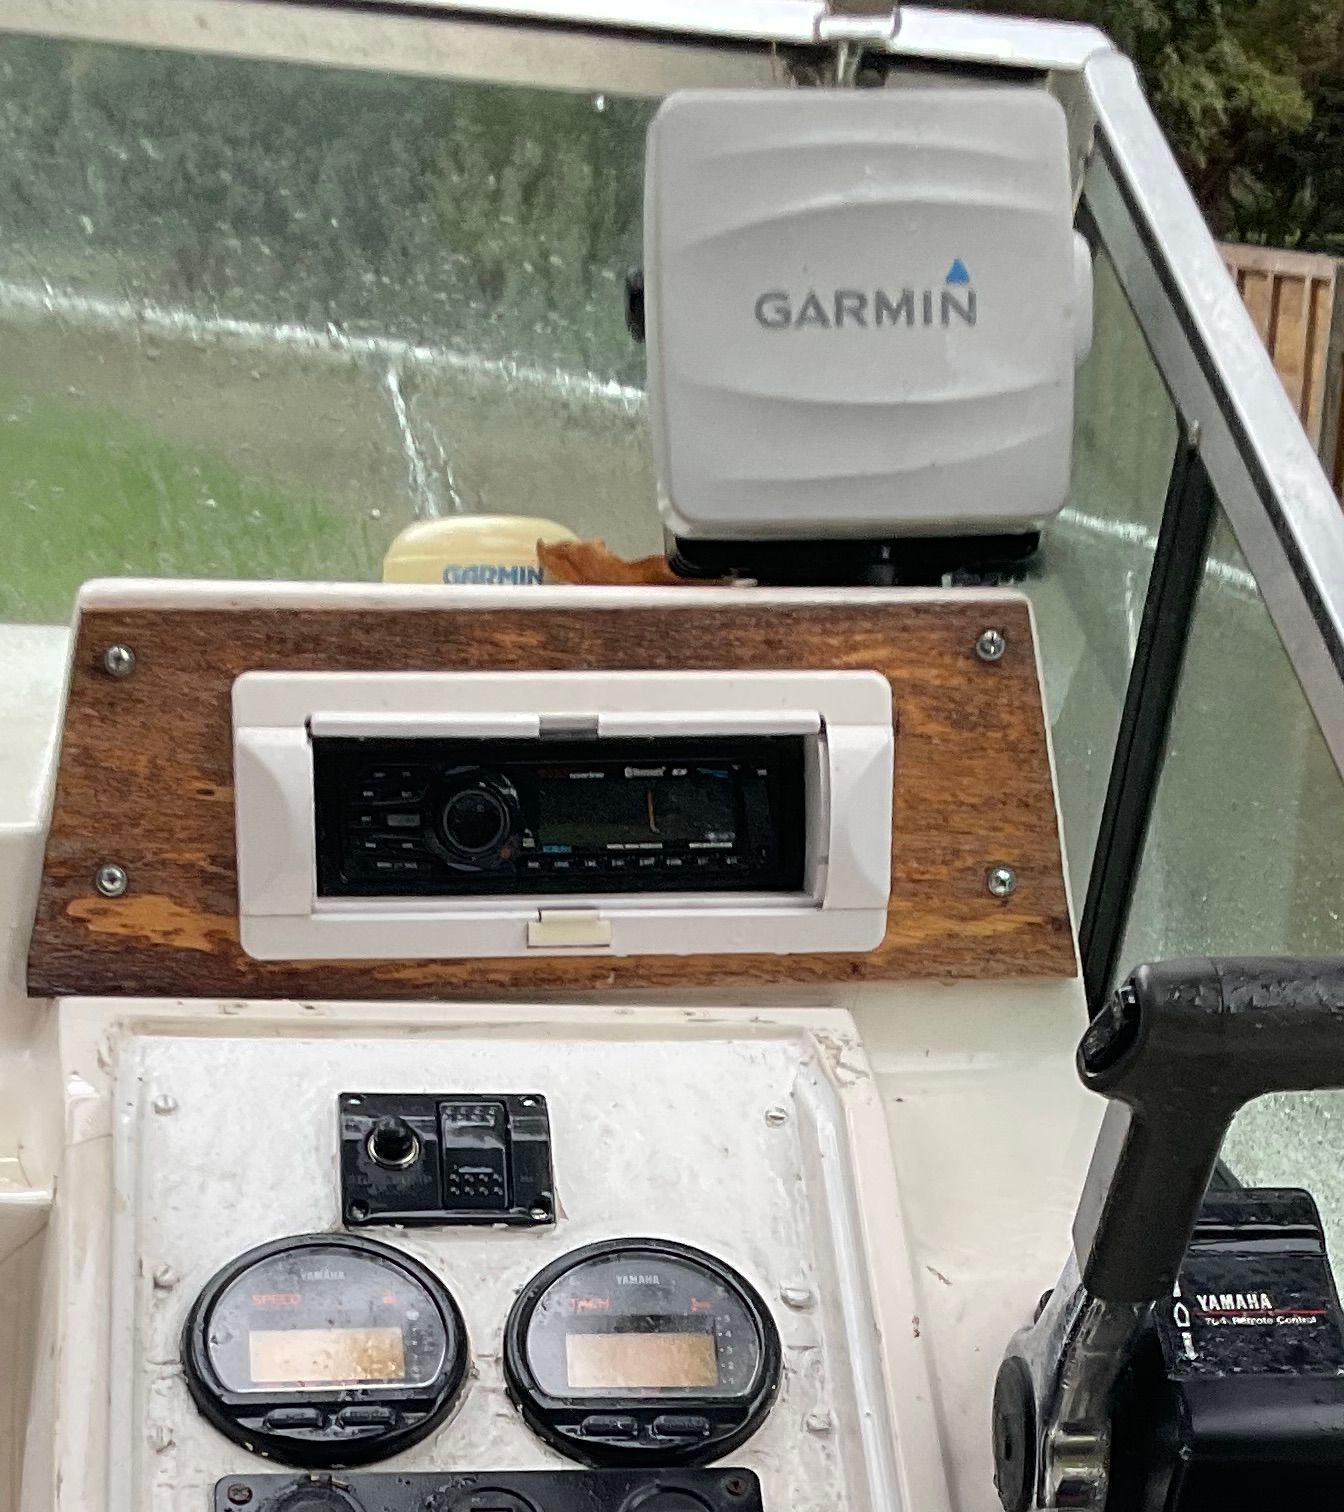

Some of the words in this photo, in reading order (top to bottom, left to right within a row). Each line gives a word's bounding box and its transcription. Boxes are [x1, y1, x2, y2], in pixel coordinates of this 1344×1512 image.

[754, 287, 977, 330] GARMIN
[442, 563, 544, 586] GARMIN
[301, 1269, 346, 1281] YAMAHA
[615, 1274, 661, 1286] YAMAHA
[1196, 1292, 1273, 1312] YAMAHA
